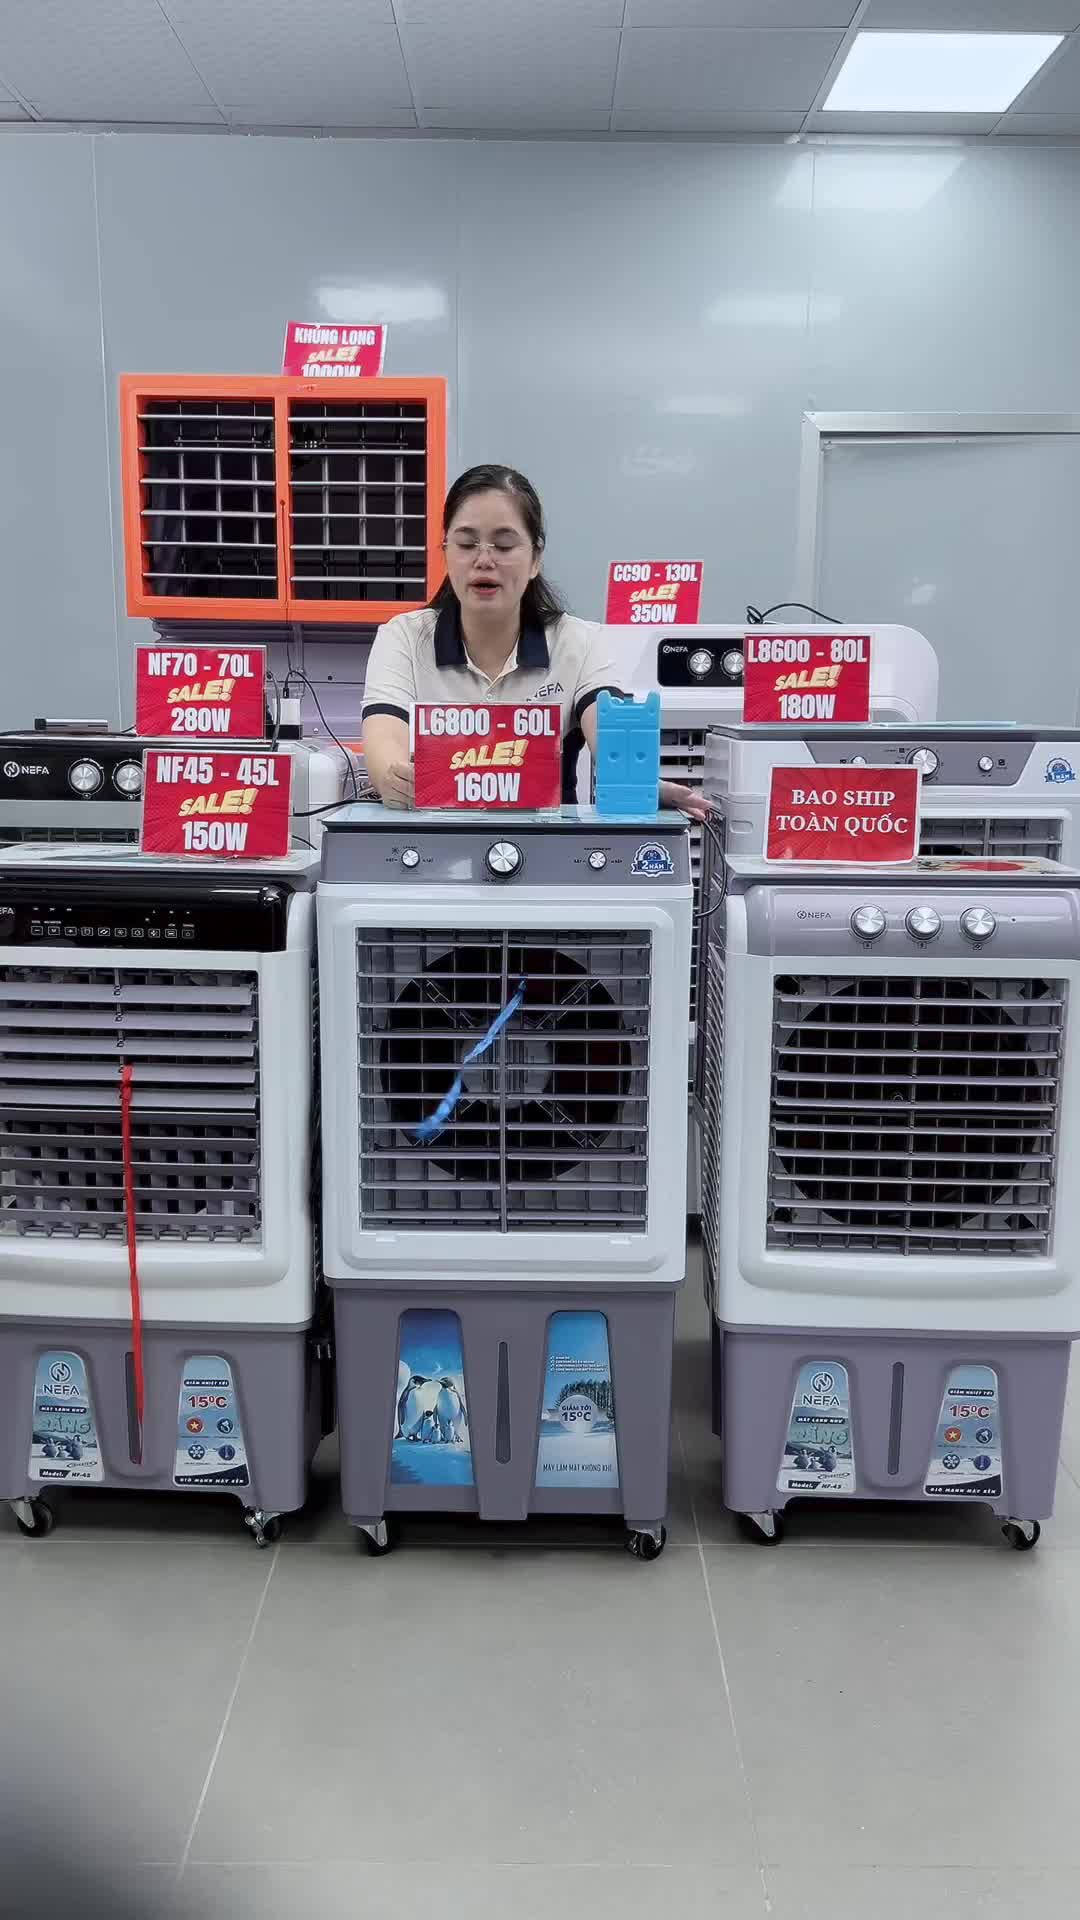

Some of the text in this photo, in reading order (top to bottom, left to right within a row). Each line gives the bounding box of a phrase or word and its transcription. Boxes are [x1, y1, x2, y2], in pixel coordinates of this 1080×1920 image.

[294, 325, 376, 346] KHỦNG LONG
[306, 345, 361, 363] SALE!
[301, 363, 361, 377] 1000W
[613, 563, 651, 582] CC90
[665, 563, 698, 582] 130L
[629, 583, 680, 603] SALE!
[630, 603, 677, 623] 350W
[747, 639, 810, 663] L8600
[830, 639, 867, 663] 80L
[148, 653, 197, 676] NF70
[217, 654, 254, 677] 70L
[774, 664, 843, 691] SALE!
[166, 678, 236, 703] SALE!
[778, 694, 836, 720] 180W
[171, 707, 230, 732] 280W
[418, 708, 490, 736] L6800
[513, 708, 555, 736] 60L
[449, 739, 529, 770] SALE!
[21, 766, 50, 775] NEFA
[156, 756, 213, 784] NF45
[236, 758, 279, 786] 45L
[454, 772, 521, 802] 160W
[791, 789, 895, 806] BAO SHIP
[178, 788, 258, 817] SALE!
[776, 812, 908, 837] TOÀN QUỐC
[182, 822, 248, 851] 150W
[641, 861, 649, 870] 2
[807, 911, 831, 919] NEFA
[43, 1385, 80, 1395] NEFA
[802, 1395, 840, 1406] NEFA
[561, 1411, 591, 1422] 15°C
